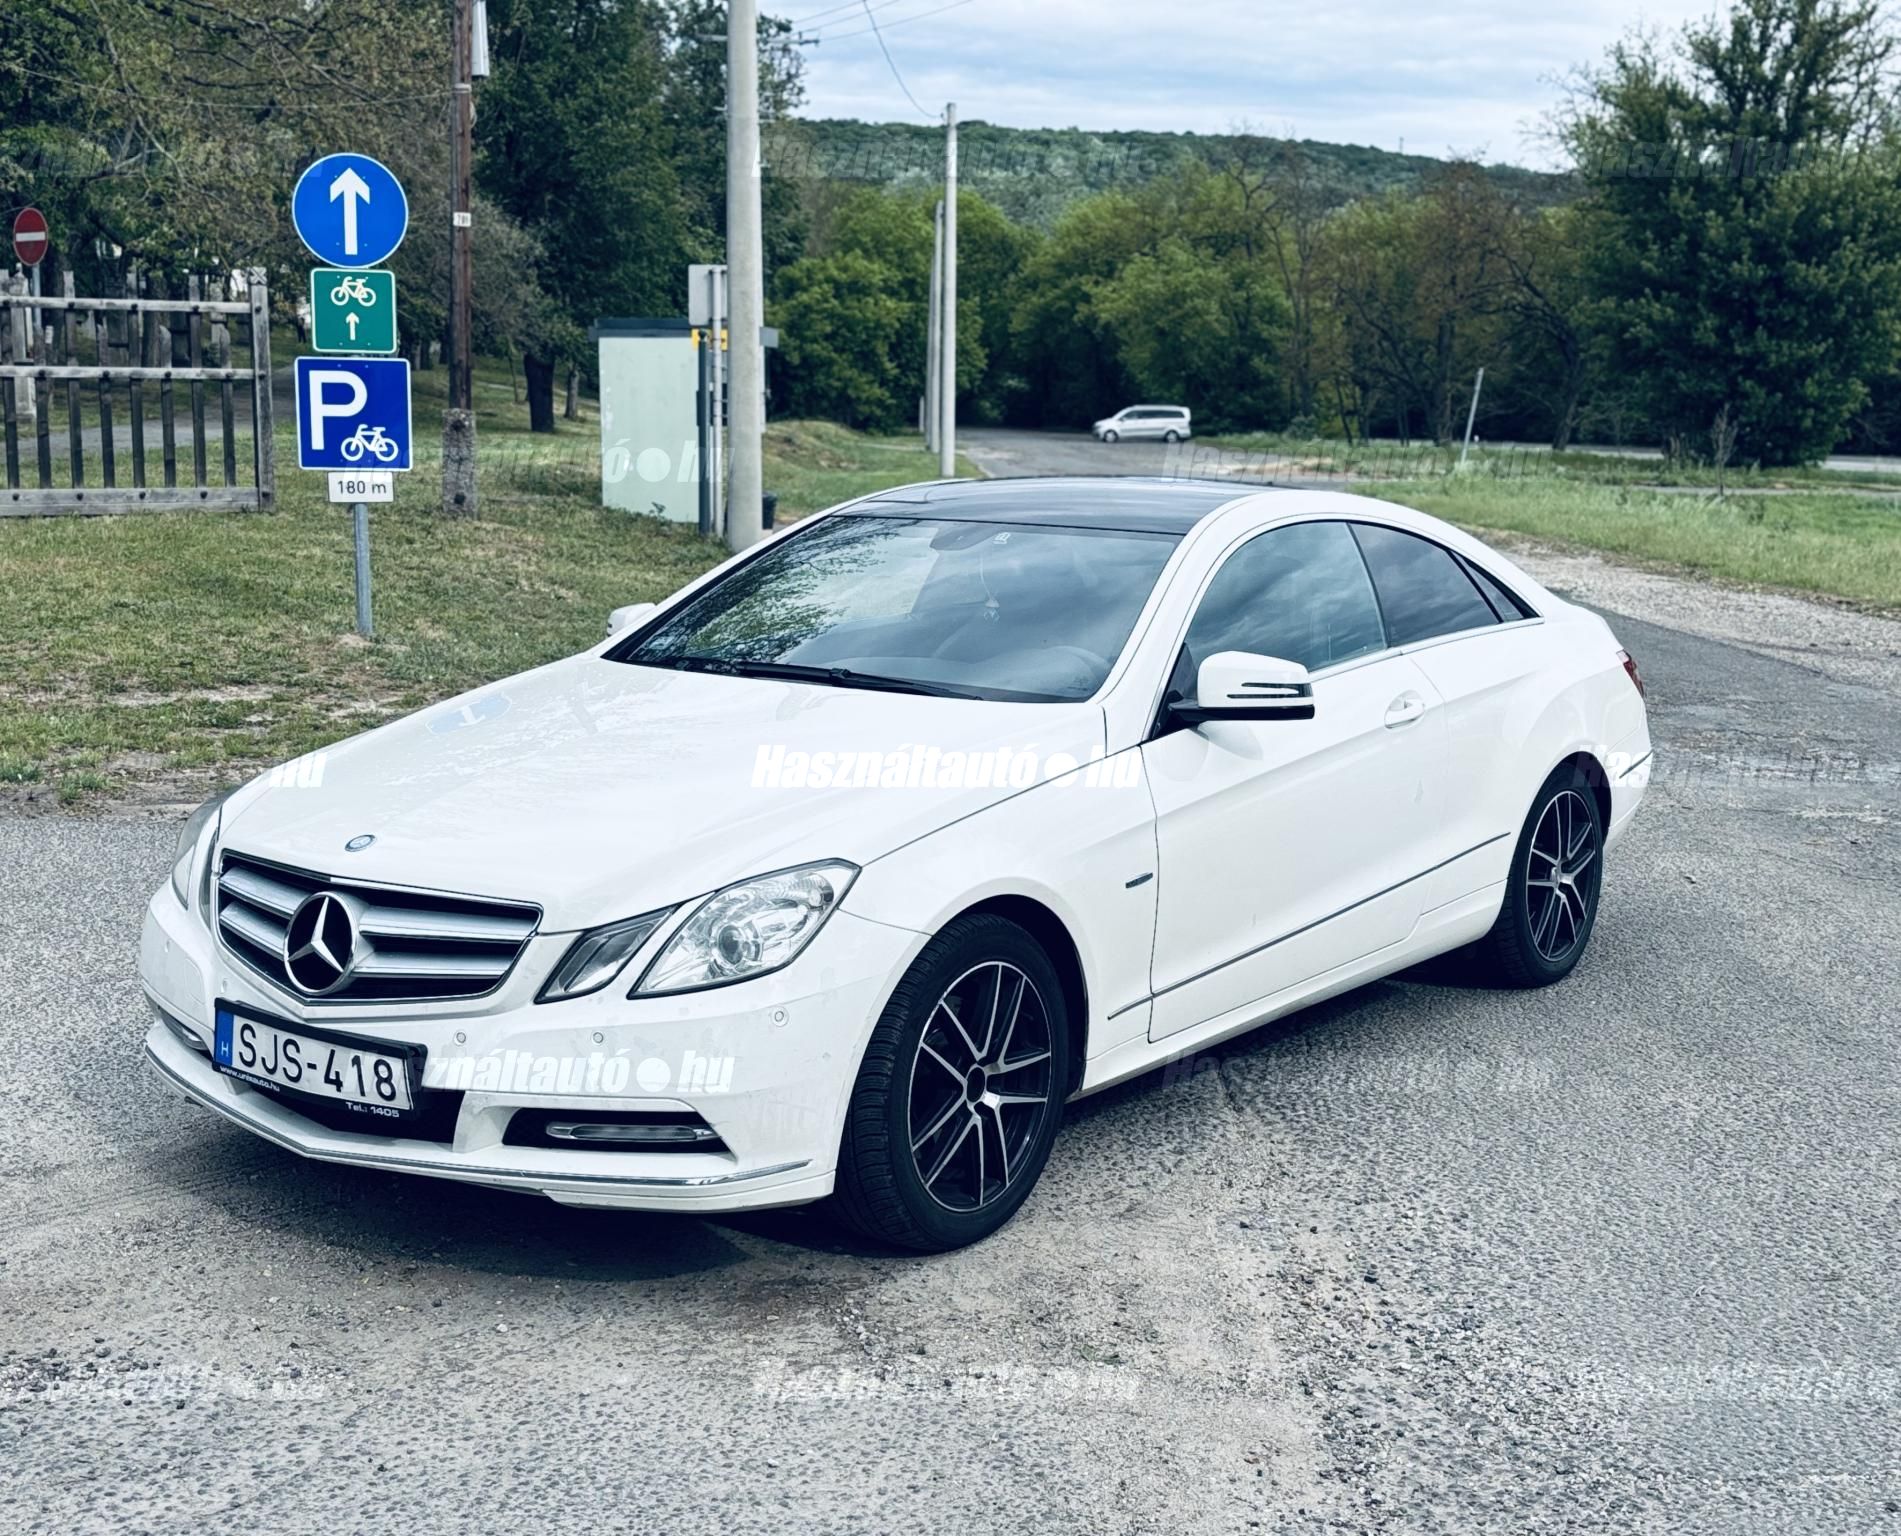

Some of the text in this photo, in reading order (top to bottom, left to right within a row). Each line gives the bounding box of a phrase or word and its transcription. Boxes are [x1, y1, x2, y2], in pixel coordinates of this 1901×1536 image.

[309, 370, 368, 450] P
[337, 480, 387, 494] 180 m
[220, 1042, 230, 1056] H
[238, 1022, 397, 1102] SJS-418
[370, 1106, 400, 1118] 1405
